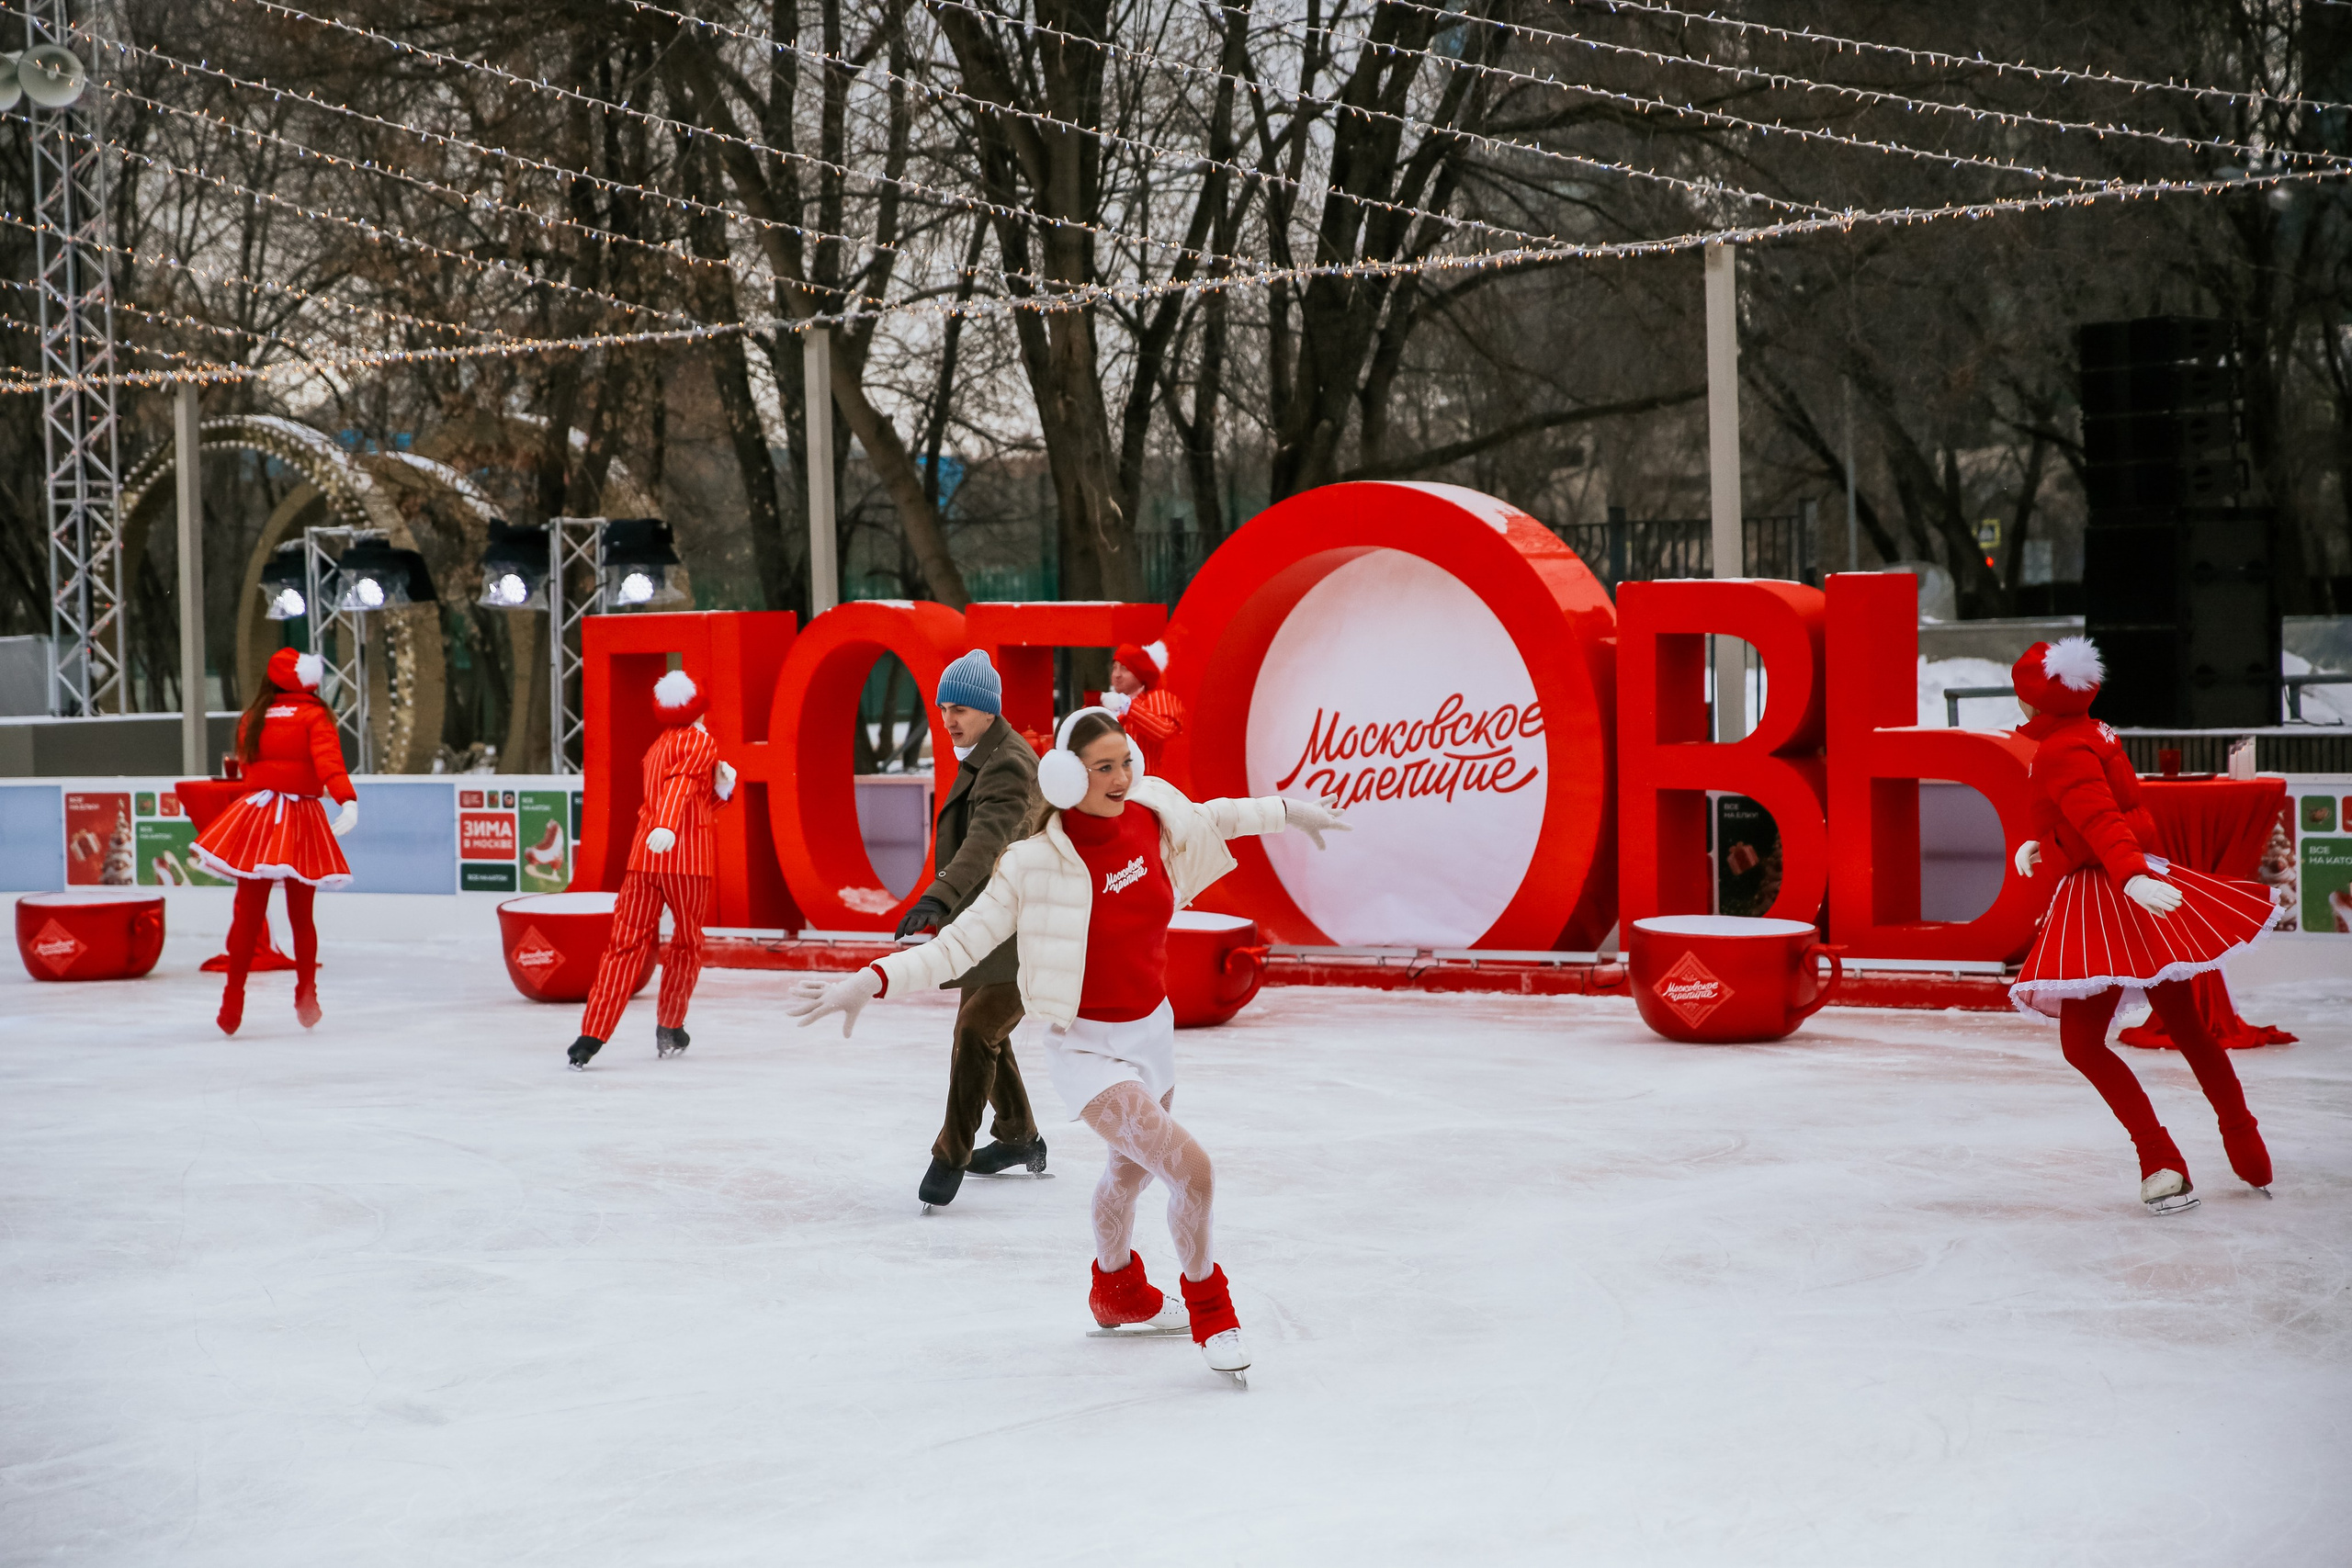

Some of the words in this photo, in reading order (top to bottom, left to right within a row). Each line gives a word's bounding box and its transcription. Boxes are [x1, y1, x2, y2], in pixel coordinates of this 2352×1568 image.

[1276, 693, 1545, 791] Московское
[463, 820, 513, 838] ЗИМА
[463, 839, 470, 849] В
[473, 839, 514, 849] МОСКВЕ
[2309, 846, 2331, 854] ВСЕ
[2309, 856, 2324, 864] НА
[1662, 980, 1719, 997] Московское
